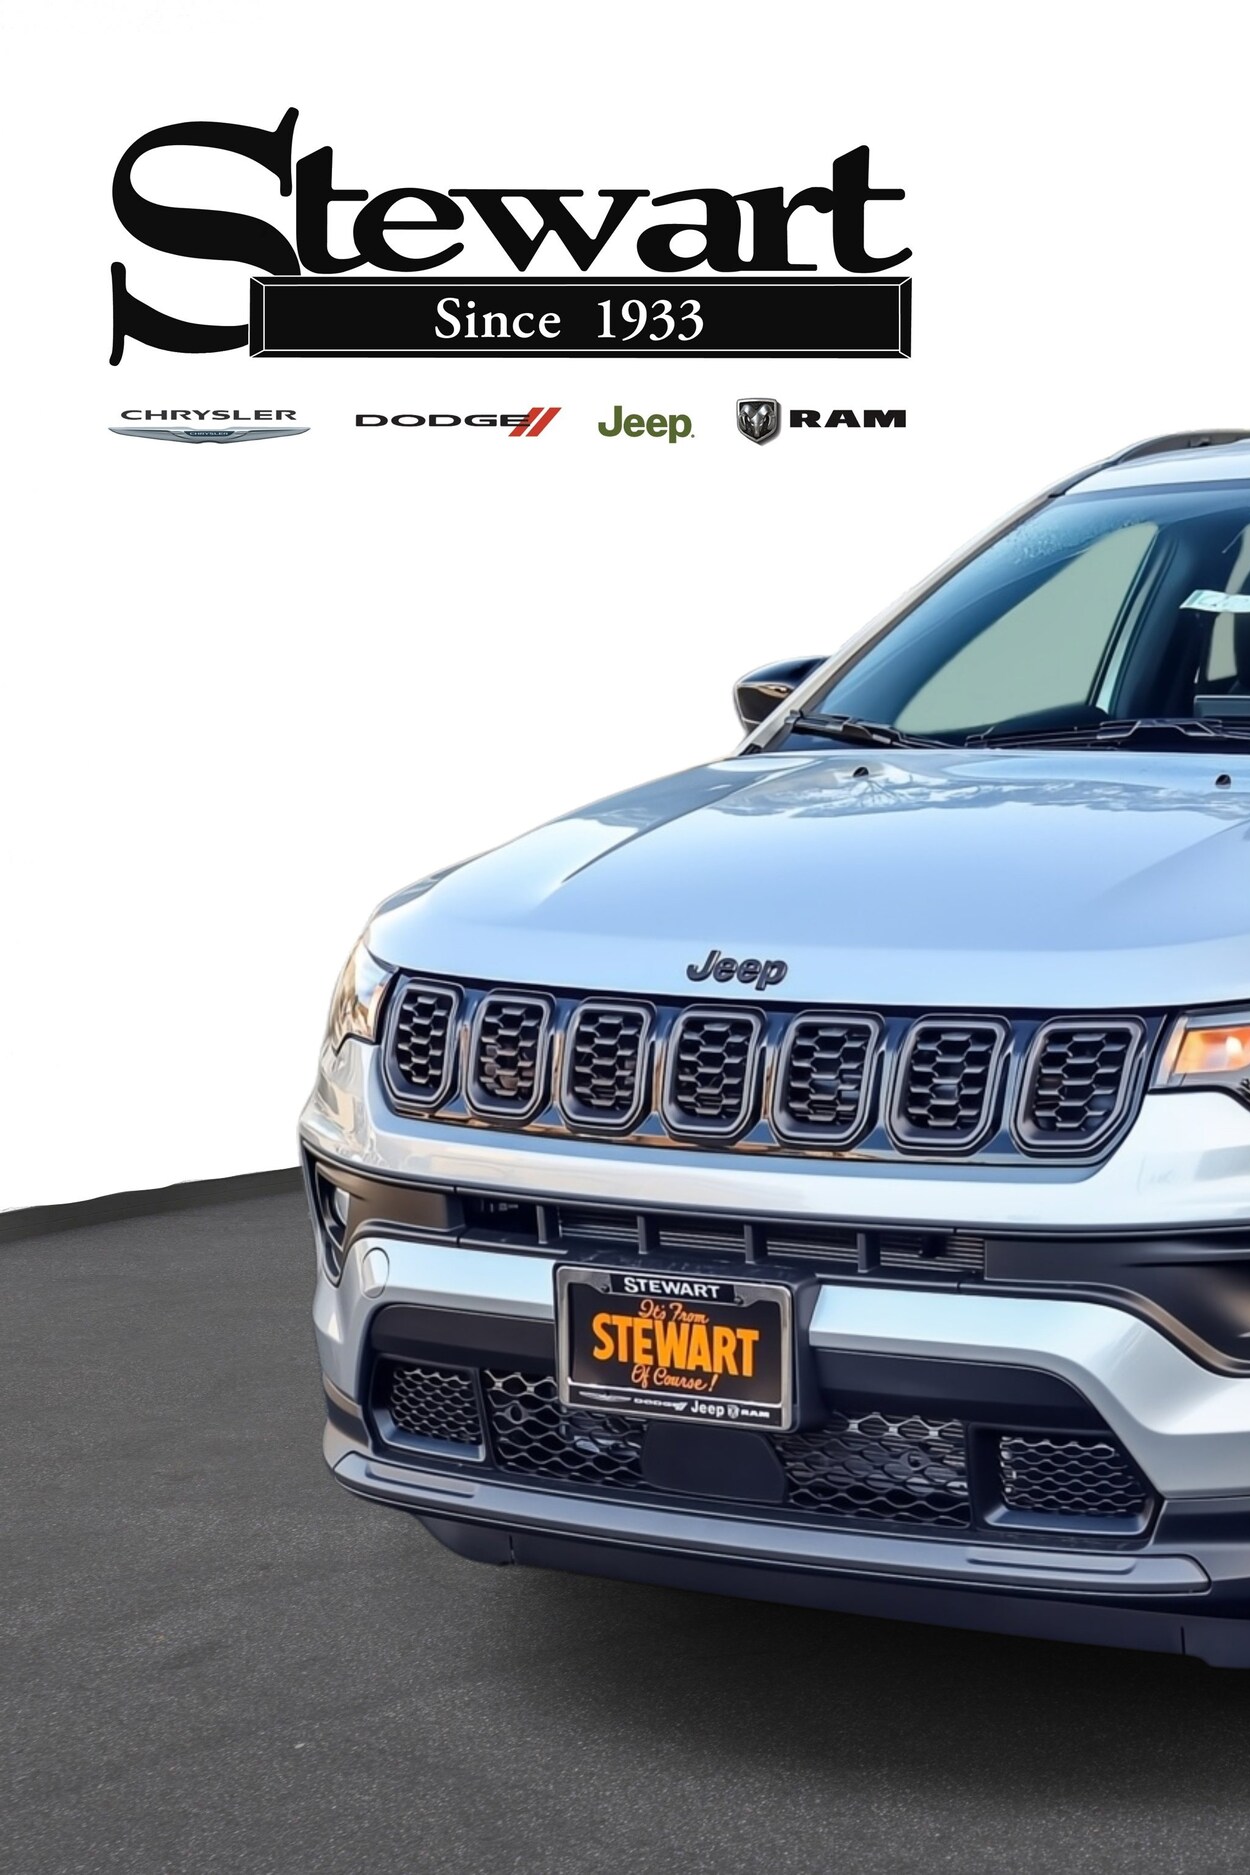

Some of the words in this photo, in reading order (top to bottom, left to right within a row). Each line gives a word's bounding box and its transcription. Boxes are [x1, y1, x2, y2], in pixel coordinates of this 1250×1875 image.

[686, 949, 788, 991] Jeep
[623, 1276, 720, 1299] STEWART
[638, 1299, 667, 1320] It's
[669, 1302, 710, 1324] From
[592, 1313, 759, 1377] STEWART
[631, 1364, 651, 1389] Of
[691, 1400, 725, 1418] Jeep
[741, 1409, 770, 1418] RAM
